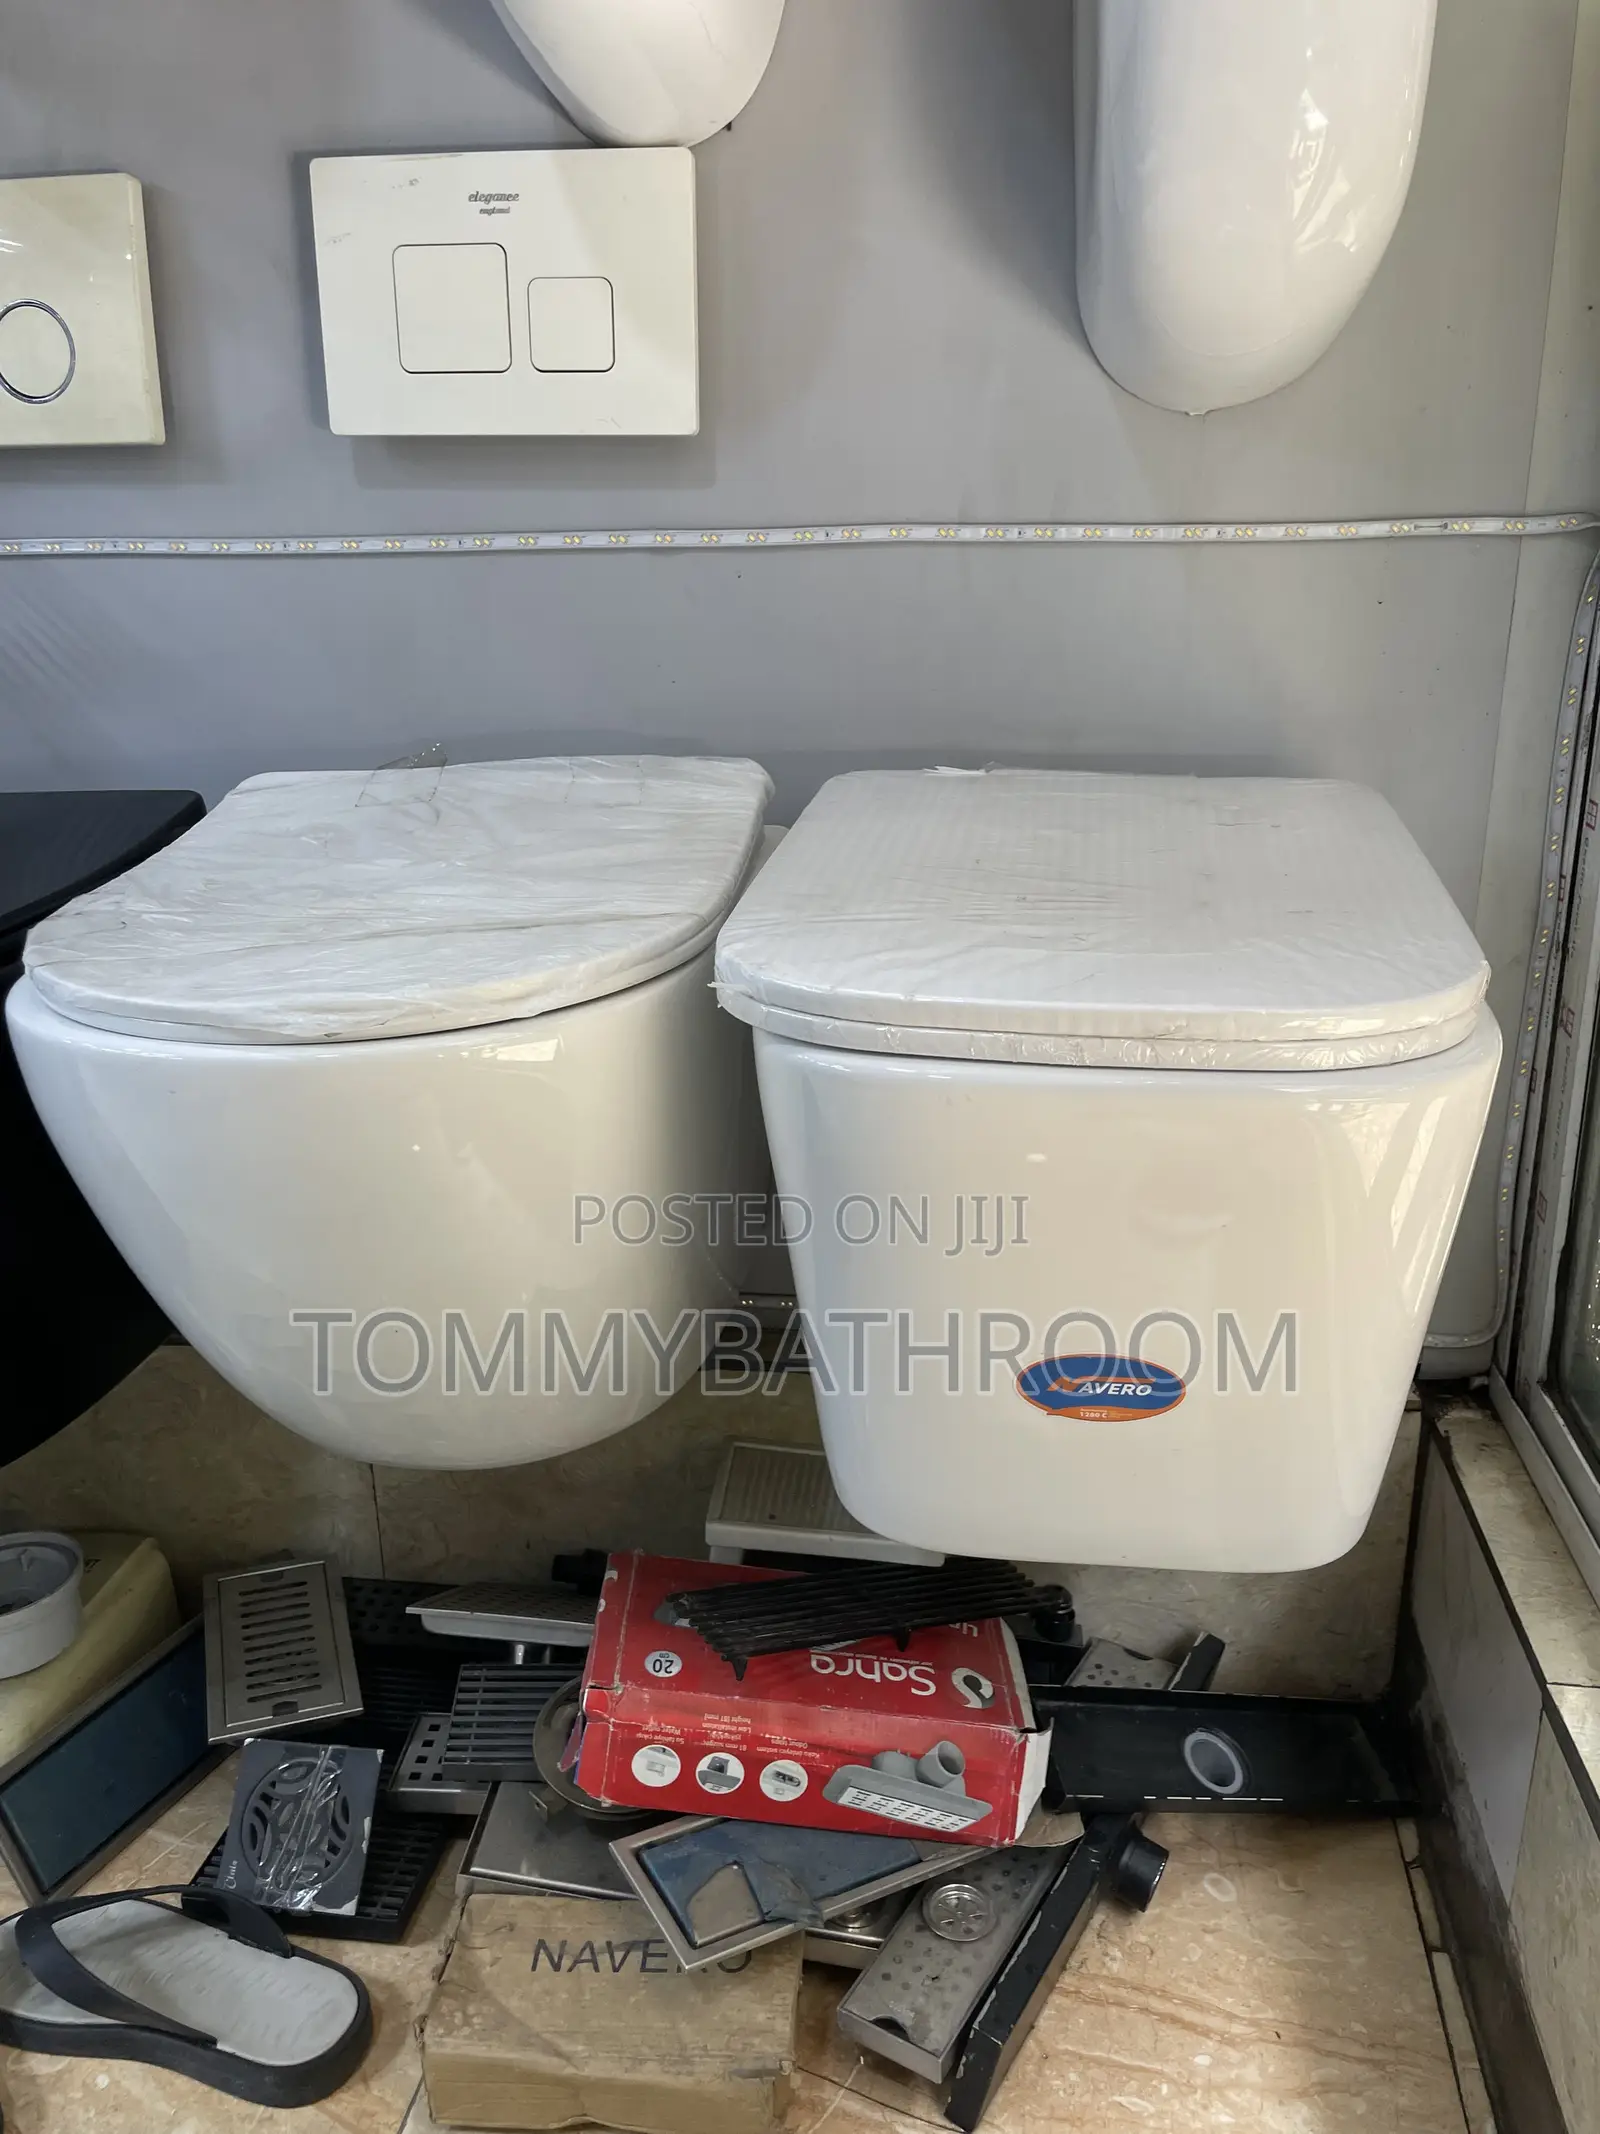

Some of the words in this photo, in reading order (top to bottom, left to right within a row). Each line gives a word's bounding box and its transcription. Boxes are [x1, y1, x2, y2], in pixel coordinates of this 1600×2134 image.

[468, 191, 520, 205] elegance
[653, 1658, 674, 1674] 20
[811, 1654, 937, 1696] Sahra
